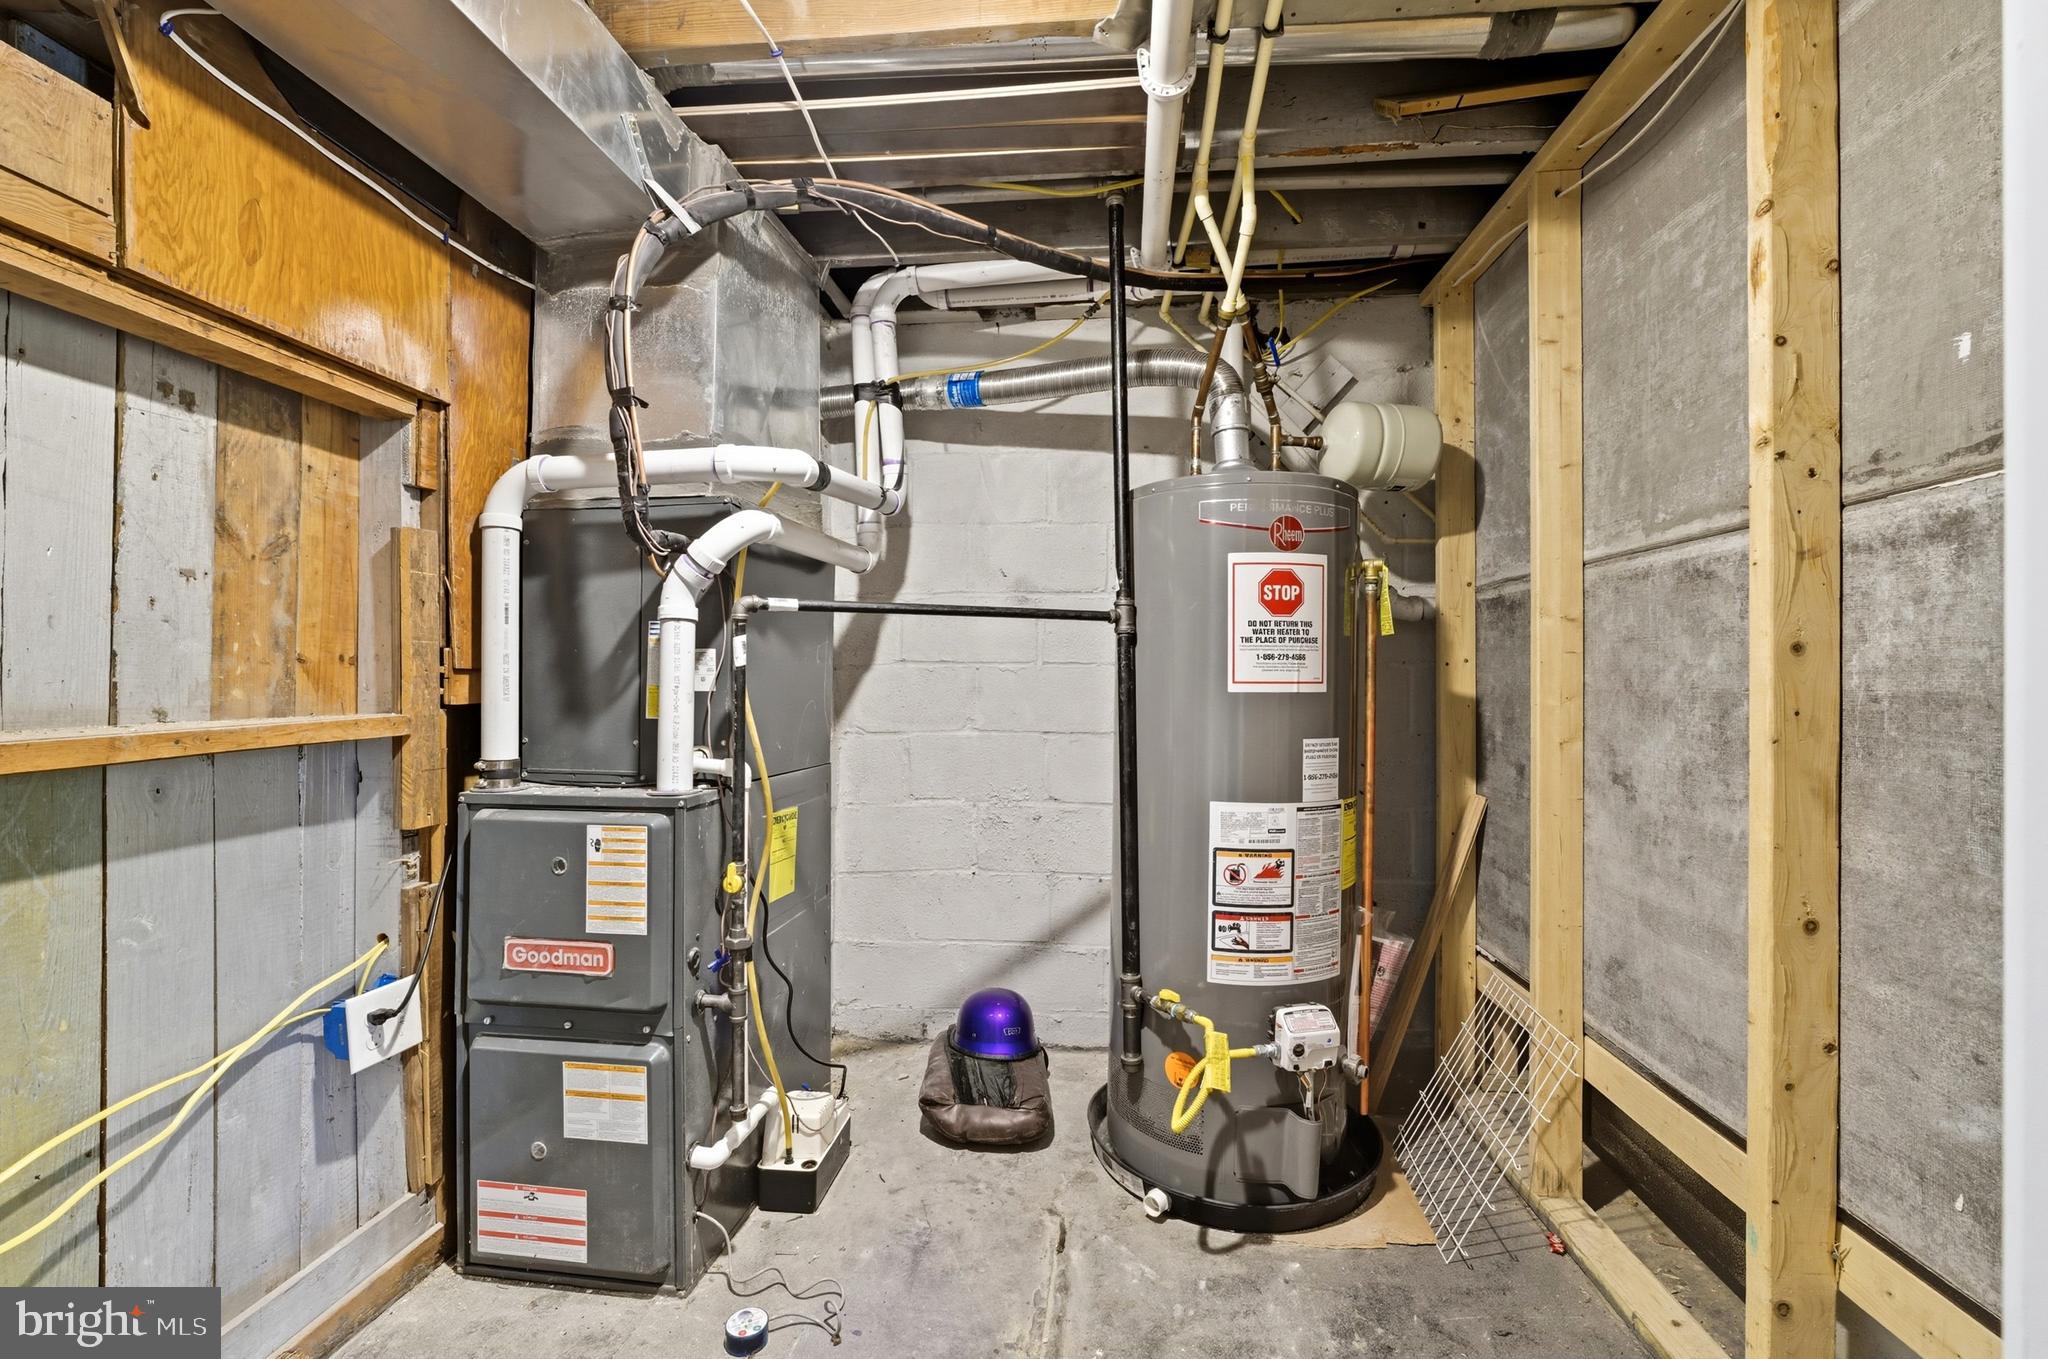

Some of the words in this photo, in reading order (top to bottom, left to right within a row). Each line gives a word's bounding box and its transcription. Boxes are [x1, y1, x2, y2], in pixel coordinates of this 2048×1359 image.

[1273, 515, 1304, 547] Rheem
[1263, 585, 1300, 601] STOP
[1247, 620, 1258, 628] DO
[1259, 620, 1272, 628] NOT
[1274, 620, 1299, 628] RETURN
[1300, 620, 1313, 628] THIS
[1252, 628, 1275, 636] WATER
[1277, 628, 1301, 636] HEATER
[1240, 636, 1253, 644] THE
[1255, 636, 1277, 644] PLACE
[1278, 636, 1287, 644] OF
[1288, 636, 1319, 645] PURCHASE
[512, 946, 604, 967] Goodman
